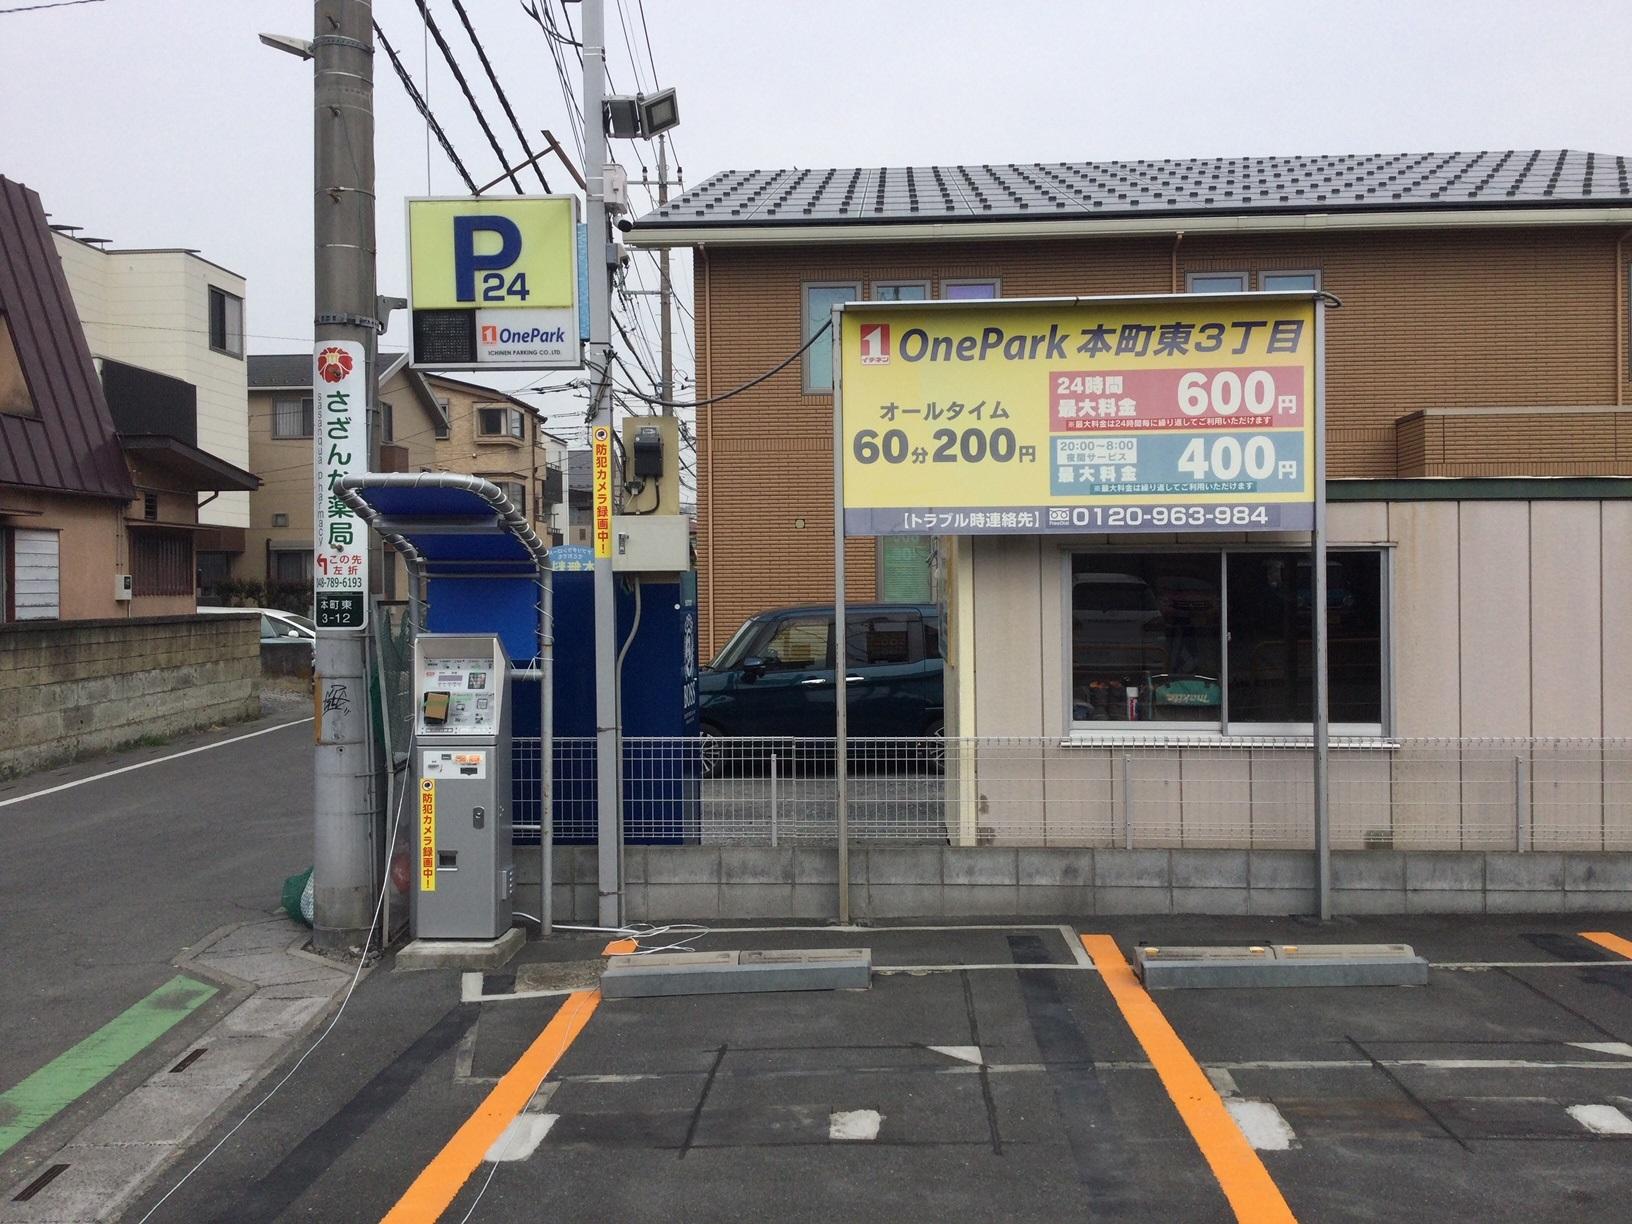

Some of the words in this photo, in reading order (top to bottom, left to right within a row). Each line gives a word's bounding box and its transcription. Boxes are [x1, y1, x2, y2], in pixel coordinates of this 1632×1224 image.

[453, 215, 522, 302] P
[483, 272, 530, 301] 24
[500, 327, 565, 343] OnePark
[900, 324, 1070, 362] OnePark
[1077, 319, 1305, 358] 本町東3丁目
[1057, 376, 1123, 394] 24時間
[1177, 370, 1297, 416] 600円
[880, 400, 1010, 422] オールタイム
[1058, 397, 1137, 417] 最大料金
[1066, 452, 1127, 462] 夜間サービス
[1177, 435, 1297, 480] 400円
[1058, 465, 1137, 482] 最大料金
[317, 471, 325, 546] pharmacy
[1072, 506, 1268, 526] 0120-963-984
[329, 555, 362, 565] この先
[333, 565, 359, 576] 左折
[320, 600, 353, 610] 本町東
[321, 613, 351, 624] 3-12
